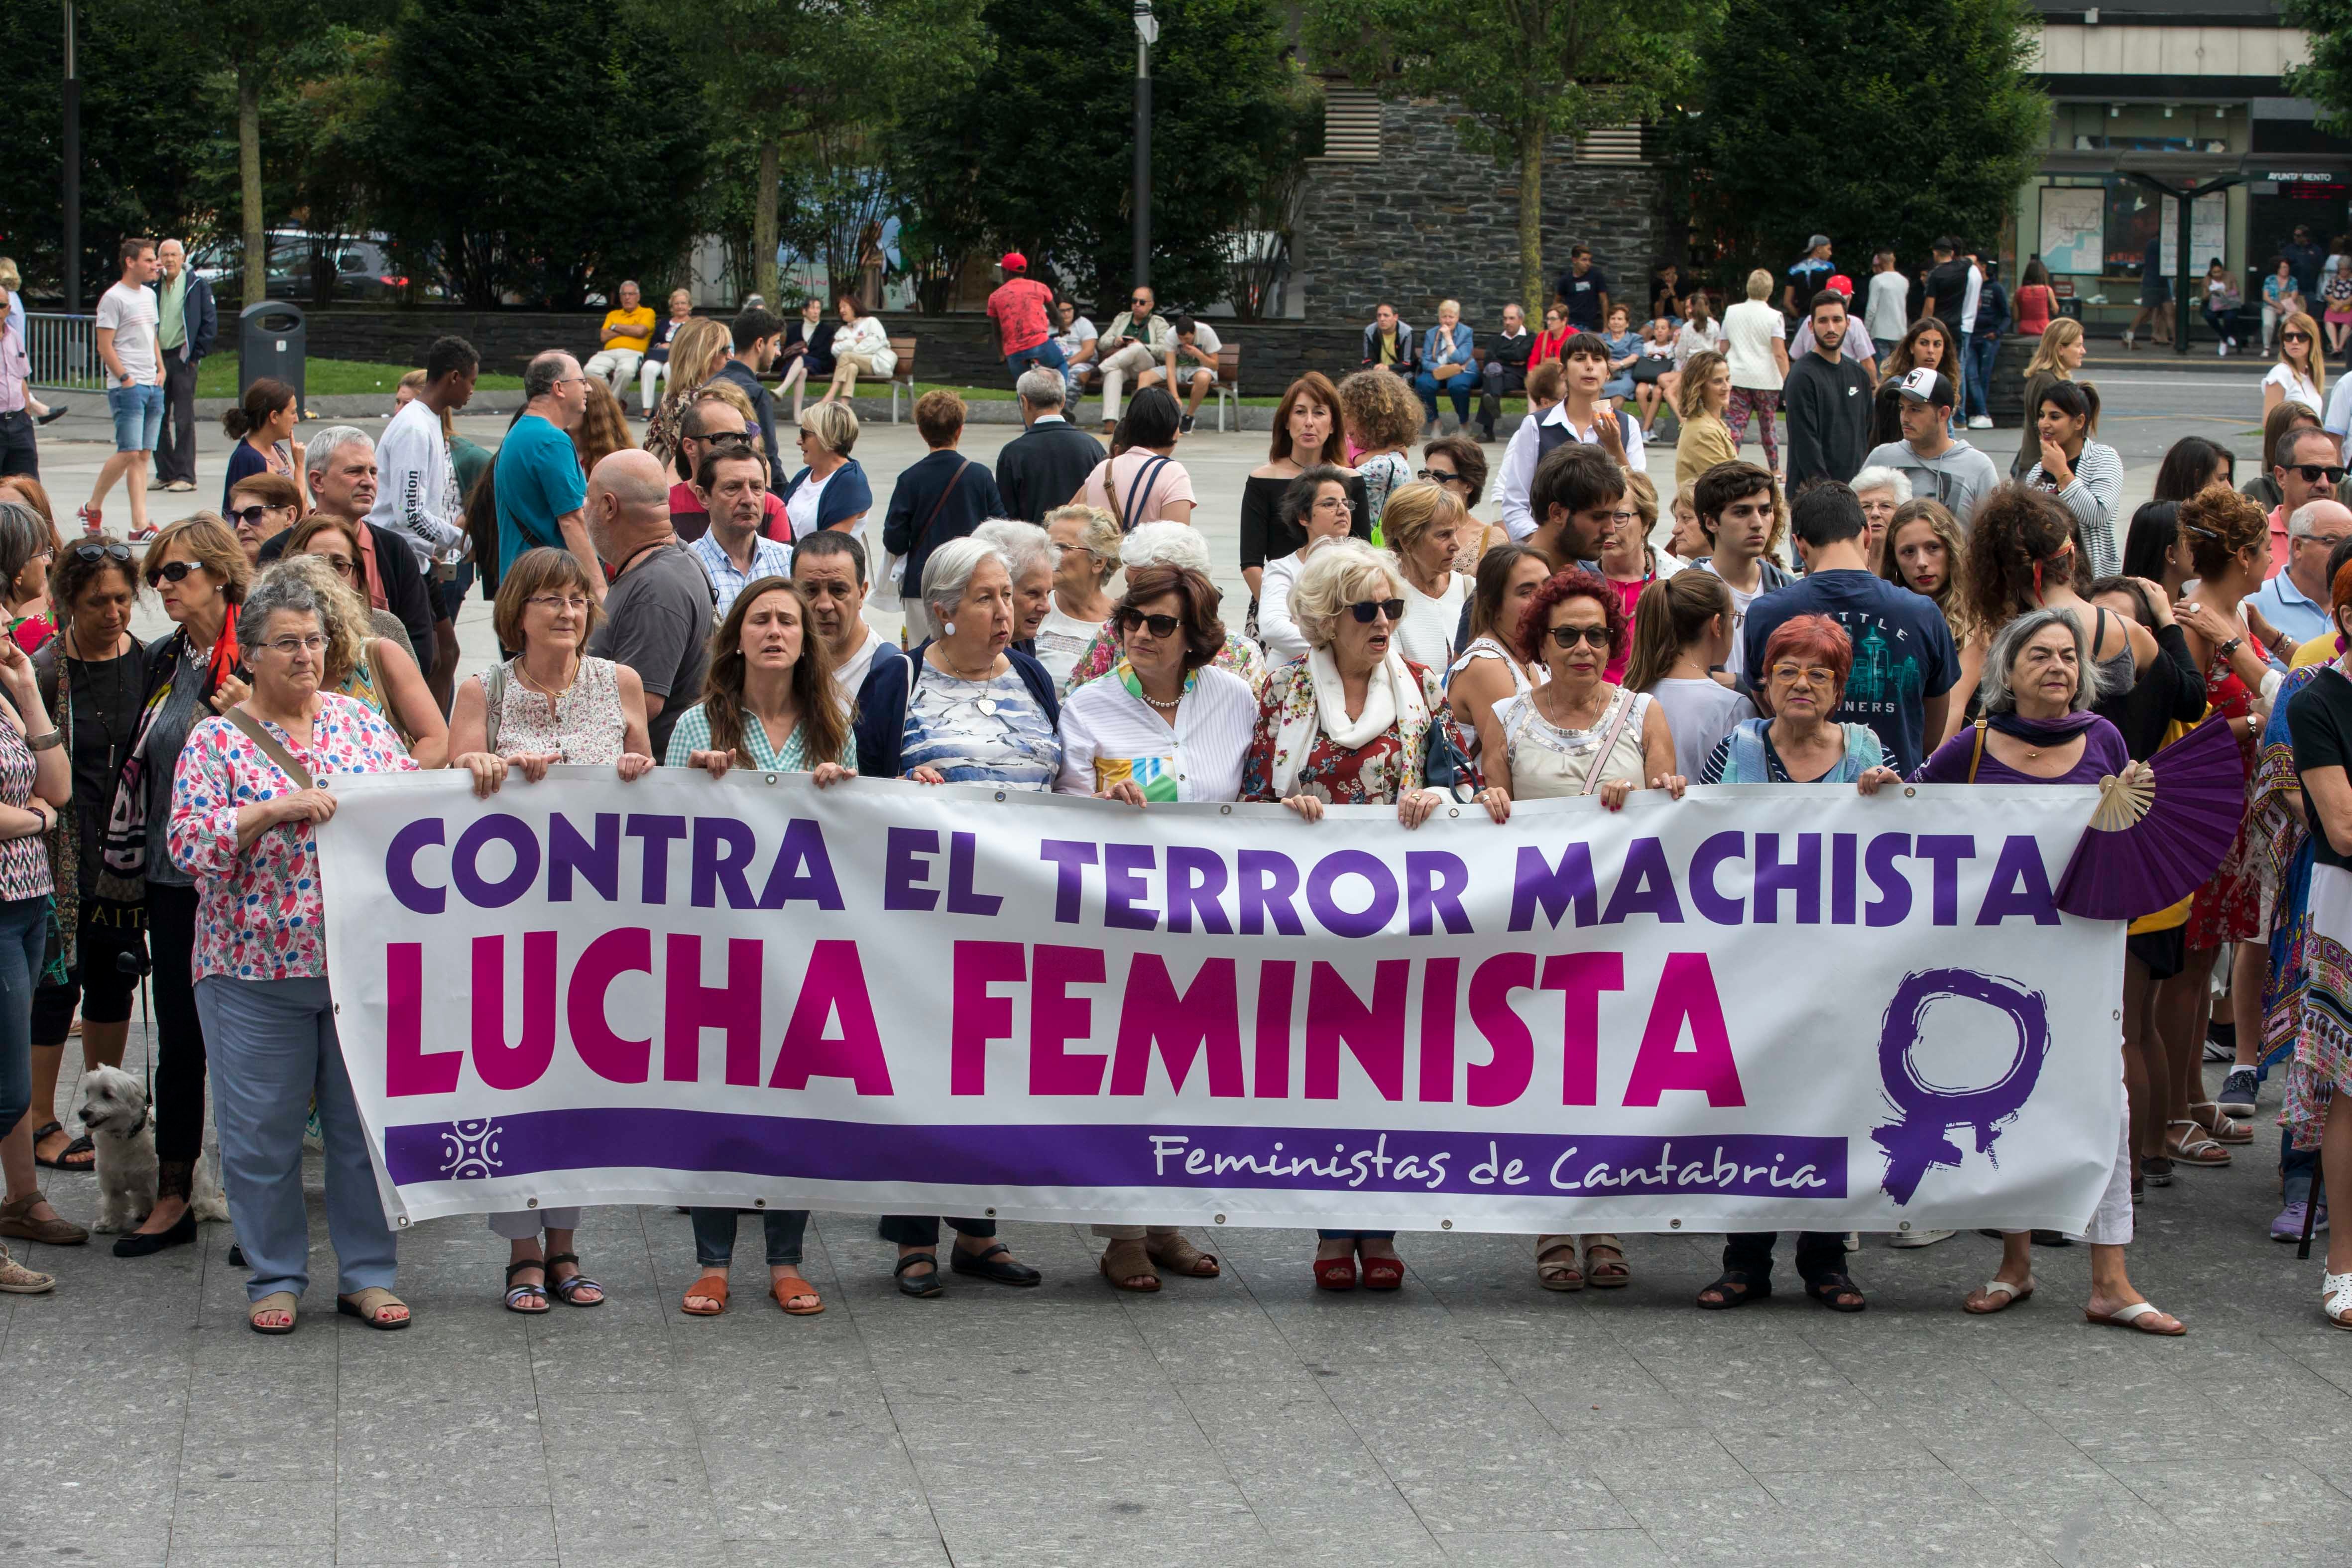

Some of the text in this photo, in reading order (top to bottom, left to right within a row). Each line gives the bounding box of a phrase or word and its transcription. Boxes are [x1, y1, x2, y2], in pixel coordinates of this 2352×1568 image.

[1824, 612, 1908, 641] TTLE
[387, 812, 2061, 938] CONTRA EL TERROR MACHISTA
[386, 927, 1746, 1107] LUCHA FEMINISTA
[1149, 1133, 1826, 1190] Feministas de Cantabria
